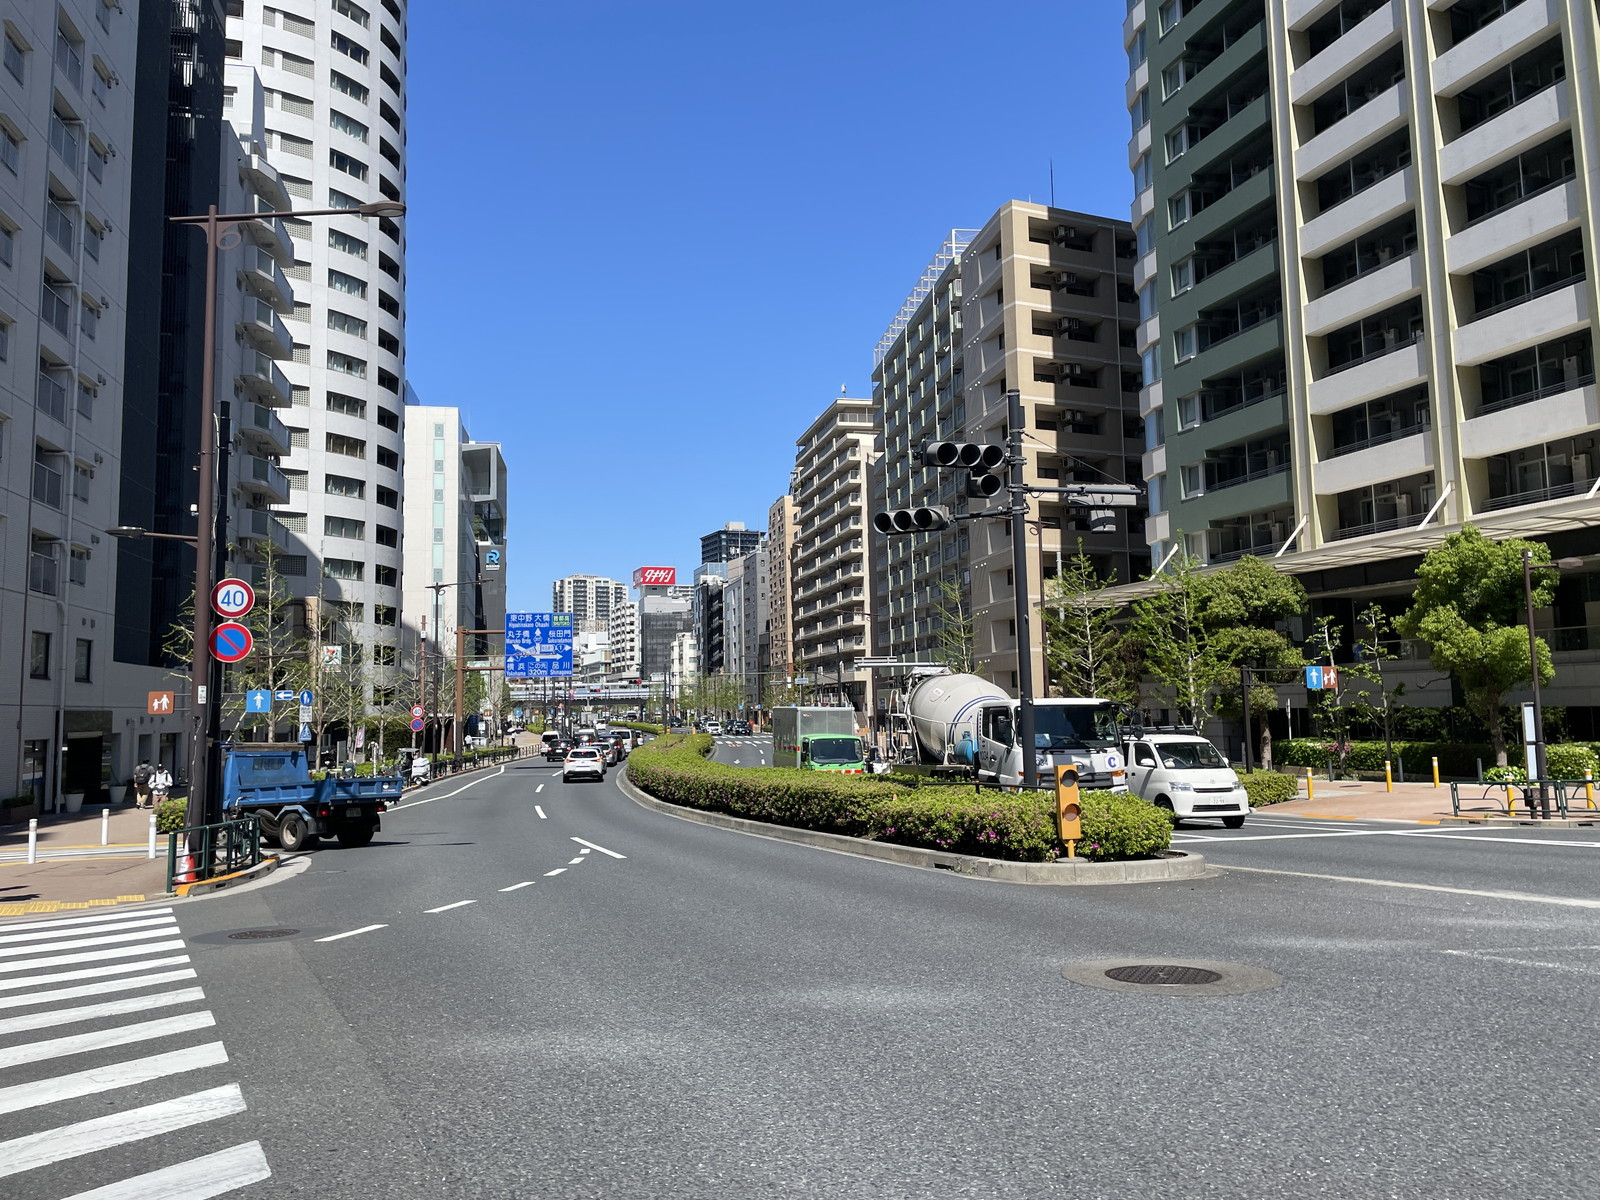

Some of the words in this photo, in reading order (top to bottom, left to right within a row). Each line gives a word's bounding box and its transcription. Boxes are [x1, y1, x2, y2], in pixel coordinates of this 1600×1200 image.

[644, 569, 674, 582] タキゲン
[221, 590, 244, 607] 40
[534, 614, 550, 622] 大橋
[548, 630, 571, 638] 桜田門
[507, 663, 526, 671] 横浜
[552, 662, 570, 670] 品川
